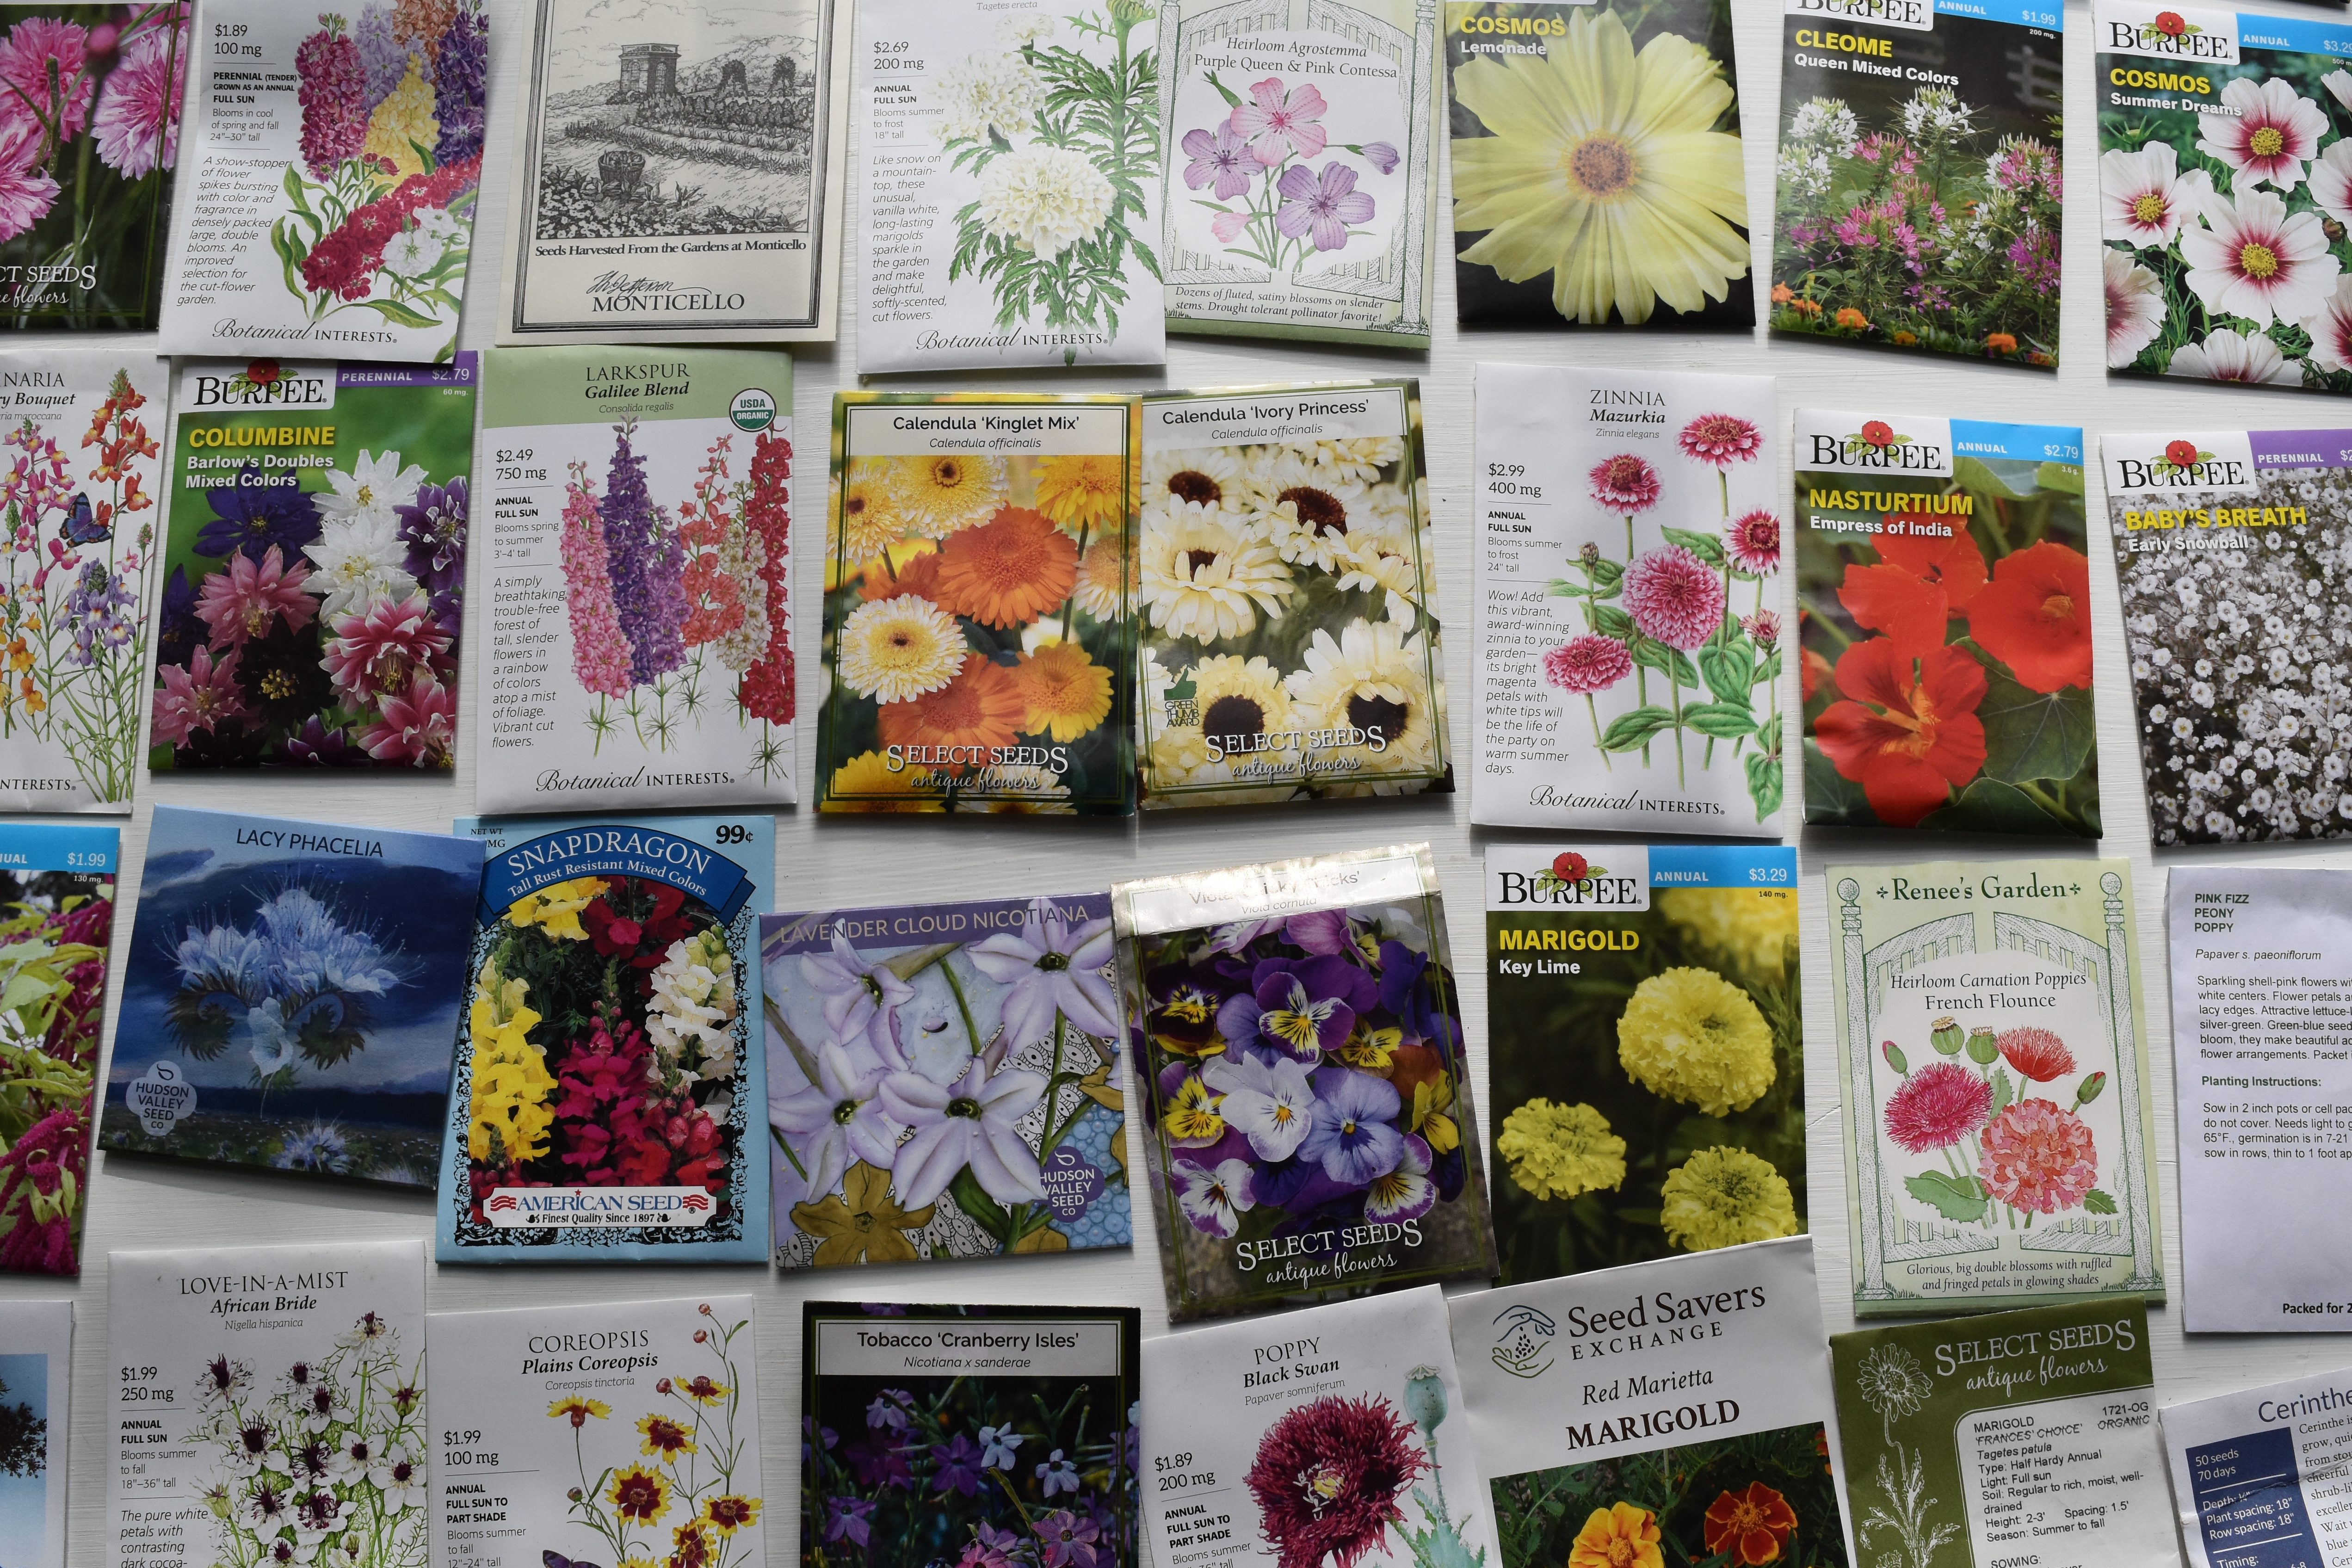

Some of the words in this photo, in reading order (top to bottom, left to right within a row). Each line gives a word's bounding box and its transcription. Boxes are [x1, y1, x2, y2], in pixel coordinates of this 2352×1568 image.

[2022, 8, 2056, 25] $1.99
[215, 23, 247, 37] $1.89
[1460, 17, 1566, 36] COSMOS
[874, 41, 908, 54] $2.69
[1227, 37, 1284, 51] Heirloom
[1288, 41, 1366, 57] Agrostemma
[1461, 41, 1547, 55] Lemonade
[1795, 29, 1892, 57] CLEOME
[2109, 22, 2228, 58] BURPEE
[215, 43, 238, 54] 100
[241, 46, 262, 57] mg
[874, 58, 899, 69] 200
[903, 60, 924, 70] mg
[1195, 54, 1236, 71] Purple
[1241, 57, 1283, 72] Queen
[1288, 60, 1301, 72] &
[1306, 62, 1335, 74] Pink
[1340, 63, 1396, 78] Contessa
[1795, 53, 1847, 70] Queen
[1853, 60, 1901, 78] Mixed
[1906, 68, 1958, 85] Colors
[2110, 68, 2210, 93] COSMOS
[2111, 93, 2178, 111] Summer
[2181, 98, 2242, 116] Dreams
[536, 245, 566, 256] Seeds
[569, 244, 625, 255] Harvested
[628, 244, 658, 253] From
[662, 243, 679, 253] the
[681, 241, 729, 252] Gardens
[731, 242, 742, 251] at
[744, 239, 806, 250] Monticello
[27, 265, 96, 290] SEEDS
[13, 289, 69, 308] flowers
[592, 293, 744, 312] MONTICELLO
[1208, 302, 1247, 315] Drought
[1251, 304, 1288, 315] tolerant
[1290, 307, 1336, 319] pollinator
[1339, 310, 1381, 322] favorite!
[212, 318, 316, 340] Botanical
[916, 327, 1021, 350] Botanical
[432, 367, 469, 381] $2.79
[586, 364, 690, 381] LARKSPUR
[194, 377, 323, 406] BURPEE
[586, 384, 639, 398] Galilee
[643, 382, 689, 396] Blend
[1591, 390, 1666, 406] ZINNIA
[14, 393, 76, 408] Bouquet
[599, 403, 642, 413] Consolida
[646, 402, 673, 412] regalis
[741, 399, 765, 408] USDA
[1163, 407, 1246, 424] Calendula
[1251, 406, 1293, 420] 'Ivory
[1299, 399, 1368, 416] Princess'
[1589, 409, 1665, 423] Mazurkia
[894, 416, 976, 430] Calendula
[982, 416, 1043, 433] 'Kinglet
[1049, 416, 1079, 429] Mix'
[1596, 428, 1624, 437] Zinnia
[1627, 429, 1659, 439] elegans
[189, 426, 337, 447] COLUMBINE
[496, 449, 533, 463] $2.49
[1810, 435, 1940, 469] BURPEE
[2258, 454, 2324, 463] PERENNIAL
[187, 455, 257, 469] Barlow's
[264, 455, 334, 468] Doubles
[1489, 463, 1525, 477] $2.99
[186, 474, 235, 488] Mixed
[241, 473, 296, 487] Colors
[1809, 489, 1972, 514] NASTURTIUM
[1810, 516, 1883, 535] Empress
[1887, 519, 1906, 535] of
[1909, 521, 1953, 537] India
[2127, 510, 2212, 531] BABY'S
[2216, 506, 2307, 528] BREATH
[2129, 538, 2171, 555] Early
[2174, 534, 2249, 551] Snowball
[886, 745, 985, 770] SELECT
[990, 747, 1068, 773] SEEDS
[237, 828, 286, 847] LACY
[290, 833, 383, 858] PHACELIA
[67, 852, 105, 866] $1.99
[508, 832, 712, 879] SNAPDRAGON
[1749, 868, 1786, 881] $3.29
[1498, 872, 1636, 904] BURPEE
[1891, 877, 1972, 900] Renee's
[1982, 872, 2067, 898] Garden
[2195, 894, 2222, 903] PINK
[2226, 894, 2249, 904] FIZZ
[2195, 907, 2234, 918] PEONY
[781, 921, 889, 944] LAVENDER
[895, 914, 966, 935] CLOUD
[974, 905, 1089, 929] NICOTIANA
[2195, 923, 2234, 932] POPPY
[1500, 930, 1639, 950] MARIGOLD
[1500, 960, 1532, 977] Key
[1538, 960, 1580, 974] Lime
[1891, 974, 1955, 988] Heirloom
[1961, 973, 2030, 987] Carnation
[2035, 972, 2086, 989] Poppies
[1925, 994, 1984, 1009] French
[1989, 993, 2056, 1007] Flounce
[136, 1082, 189, 1099] HUDSON
[2202, 1076, 2248, 1088] Planting
[2253, 1076, 2321, 1086] Instructions:
[138, 1095, 184, 1109] VALLEY
[143, 1108, 174, 1120] SEED
[517, 1195, 623, 1210] AMERICAN
[628, 1196, 682, 1210] SEED
[542, 1213, 569, 1223] Finest
[572, 1213, 603, 1225] Quality
[606, 1213, 630, 1222] Since
[634, 1214, 654, 1222] 1897
[1237, 1231, 1334, 1271] SELECT
[1342, 1218, 1422, 1247] SEEDS
[181, 1272, 348, 1294] LOVE-IN-A-MIST
[210, 1298, 269, 1317] African
[274, 1295, 316, 1310] Bride
[1568, 1295, 1648, 1337] Seed
[1656, 1287, 1765, 1324] Savers
[529, 1330, 648, 1353] COREOPSIS
[857, 1332, 932, 1347] Tobacco
[938, 1332, 1030, 1351] 'Cranberry
[1036, 1333, 1078, 1347] Isles'
[1571, 1321, 1722, 1360] EXCHANGE
[1935, 1332, 2042, 1376] SELECT
[2049, 1319, 2136, 1352] SEEDS
[1253, 1337, 1320, 1364] POPPY
[522, 1358, 573, 1374] Plains
[579, 1352, 658, 1372] Coreopsis
[1243, 1366, 1290, 1388] Black
[1295, 1361, 1340, 1377] Swan
[1582, 1380, 1620, 1405] Red
[1627, 1370, 1713, 1398] Marietta
[2103, 1402, 2148, 1415] 1721-OG
[1566, 1399, 1740, 1450] MARIGOLD
[1974, 1417, 2034, 1433] MARIGOLD
[2196, 1455, 2208, 1466] 50
[2211, 1449, 2239, 1463] seeds
[2198, 1470, 2211, 1482] 70
[2214, 1467, 2236, 1478] days
